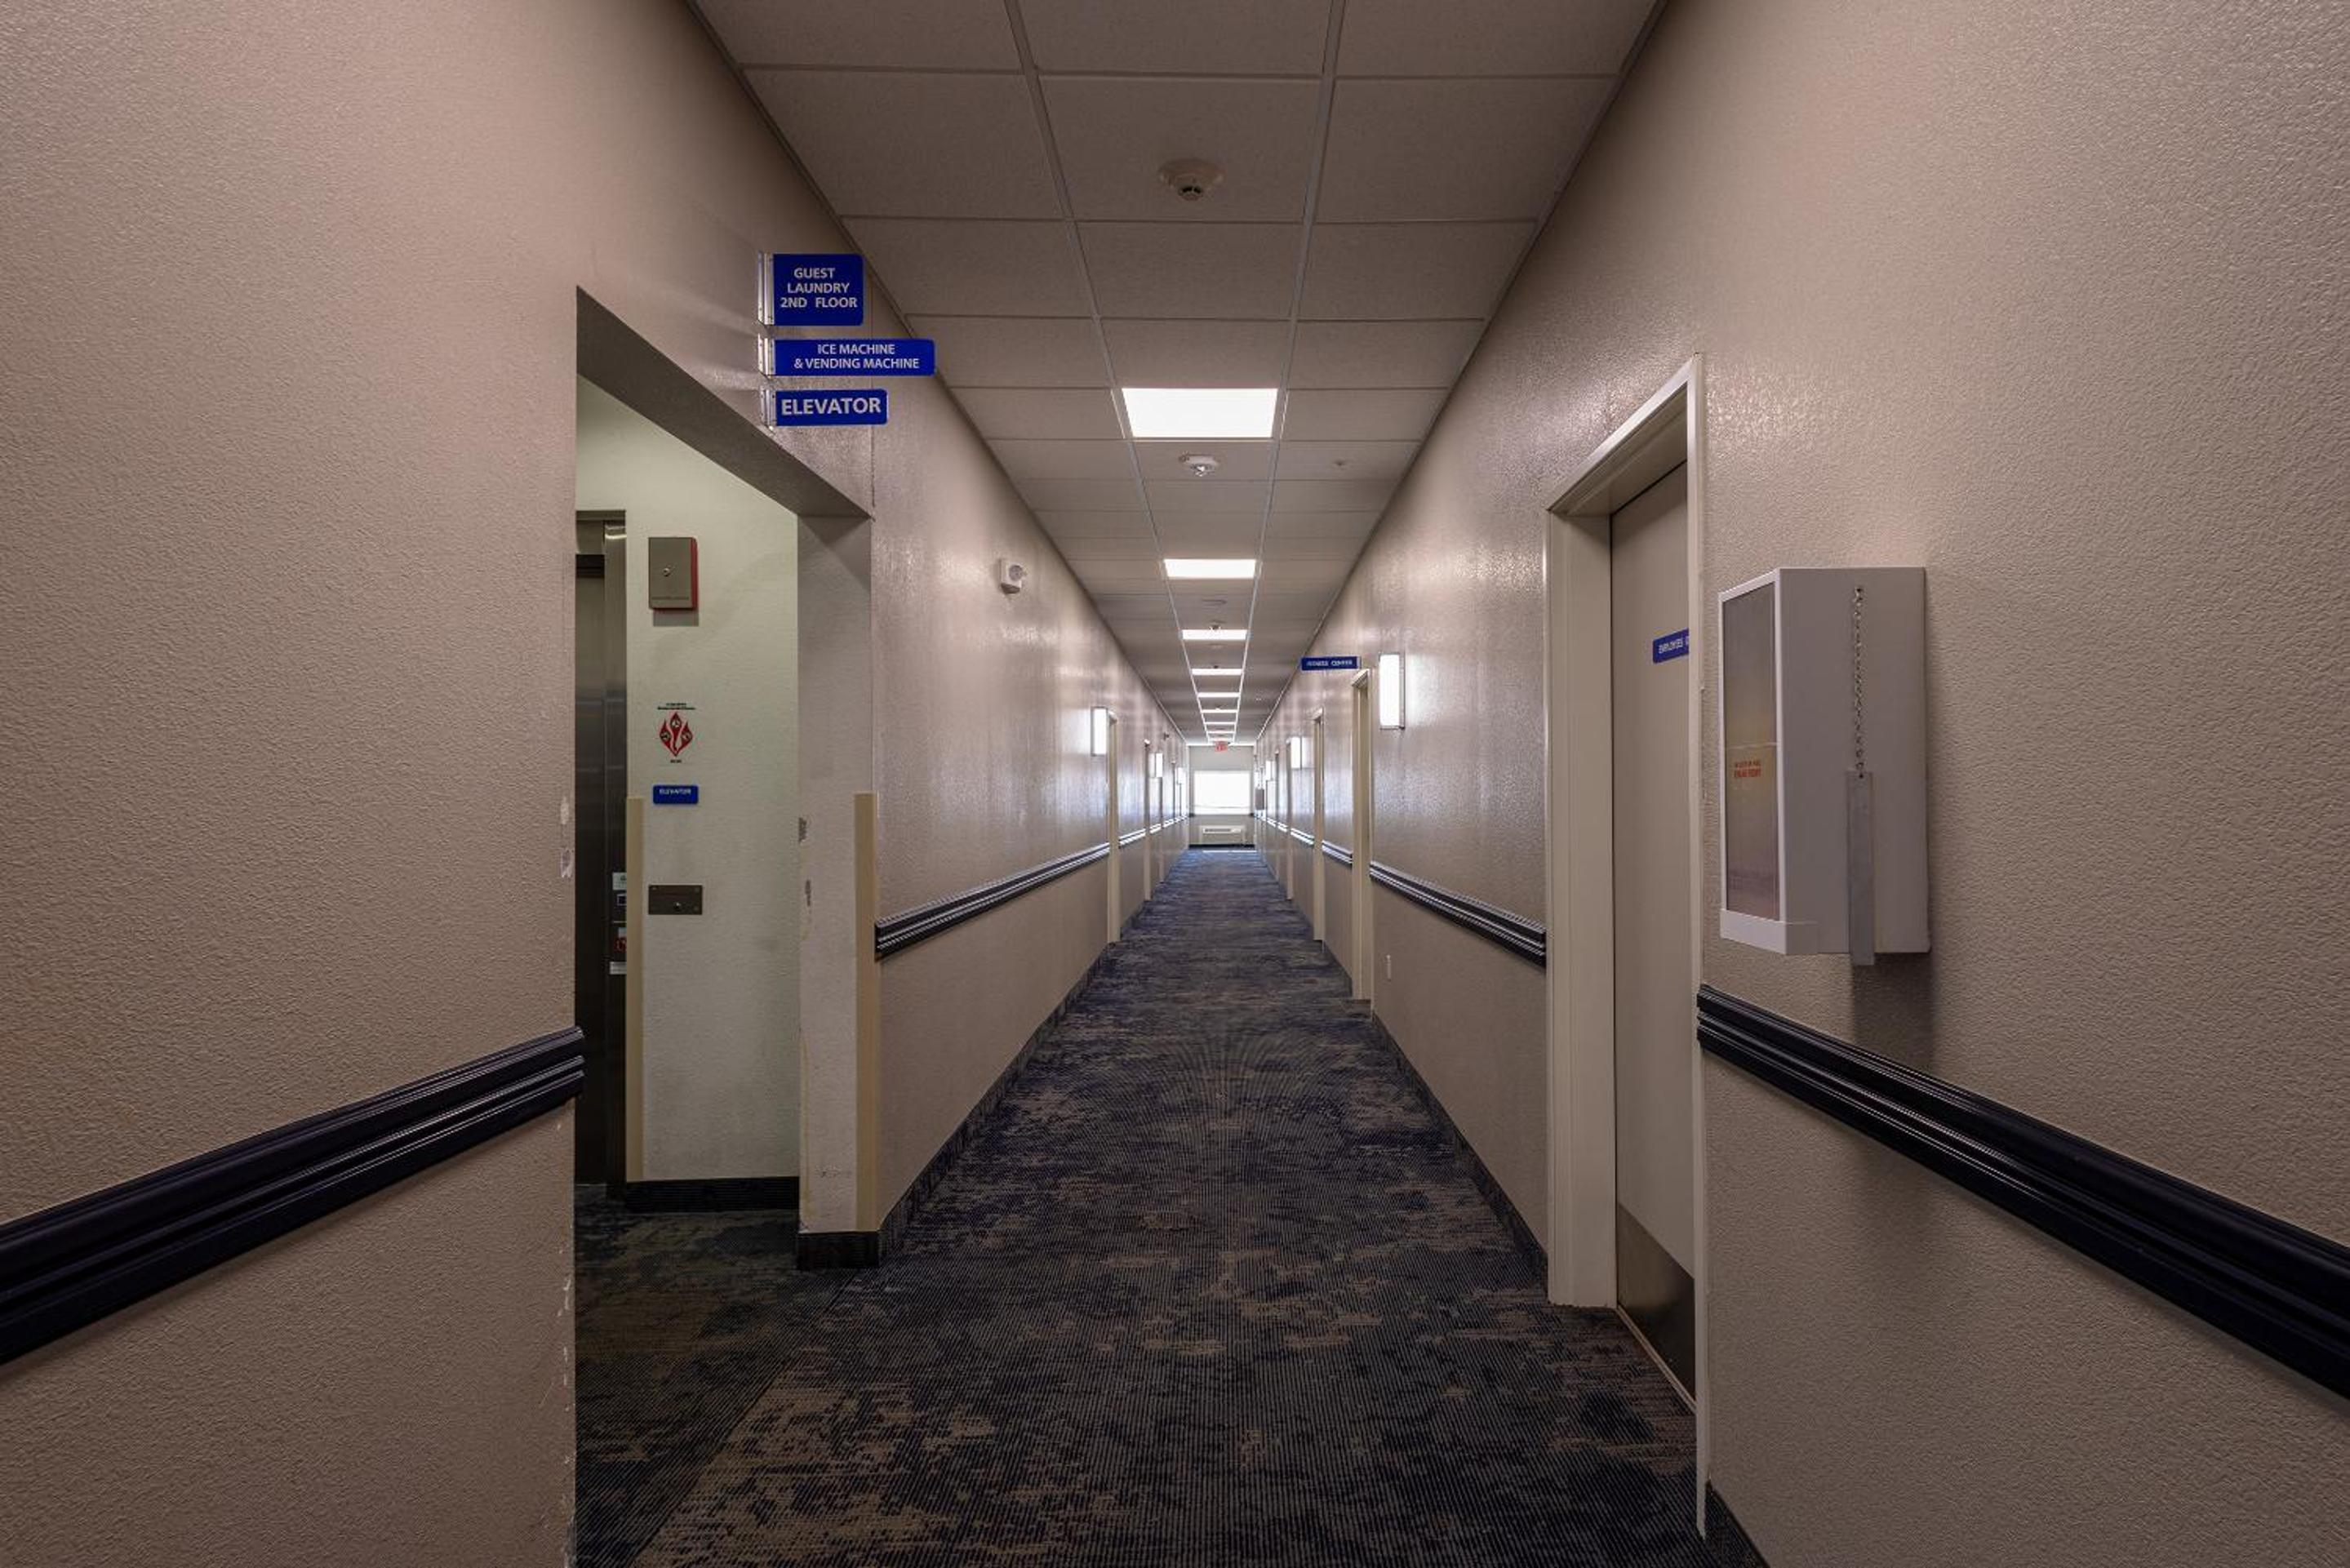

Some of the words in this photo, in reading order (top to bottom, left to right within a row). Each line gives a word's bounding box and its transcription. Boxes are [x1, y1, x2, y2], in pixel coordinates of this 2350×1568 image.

[794, 268, 835, 278] GUEST
[788, 282, 850, 294] LAUNDRY
[780, 297, 807, 308] 2ND
[815, 297, 858, 308] FLOOR
[817, 344, 836, 355] ICE
[839, 344, 895, 355] MACHINE
[793, 358, 803, 369] &
[806, 358, 860, 369] VENDING
[863, 358, 920, 369] MACHINE
[781, 398, 882, 415] ELEVATOR
